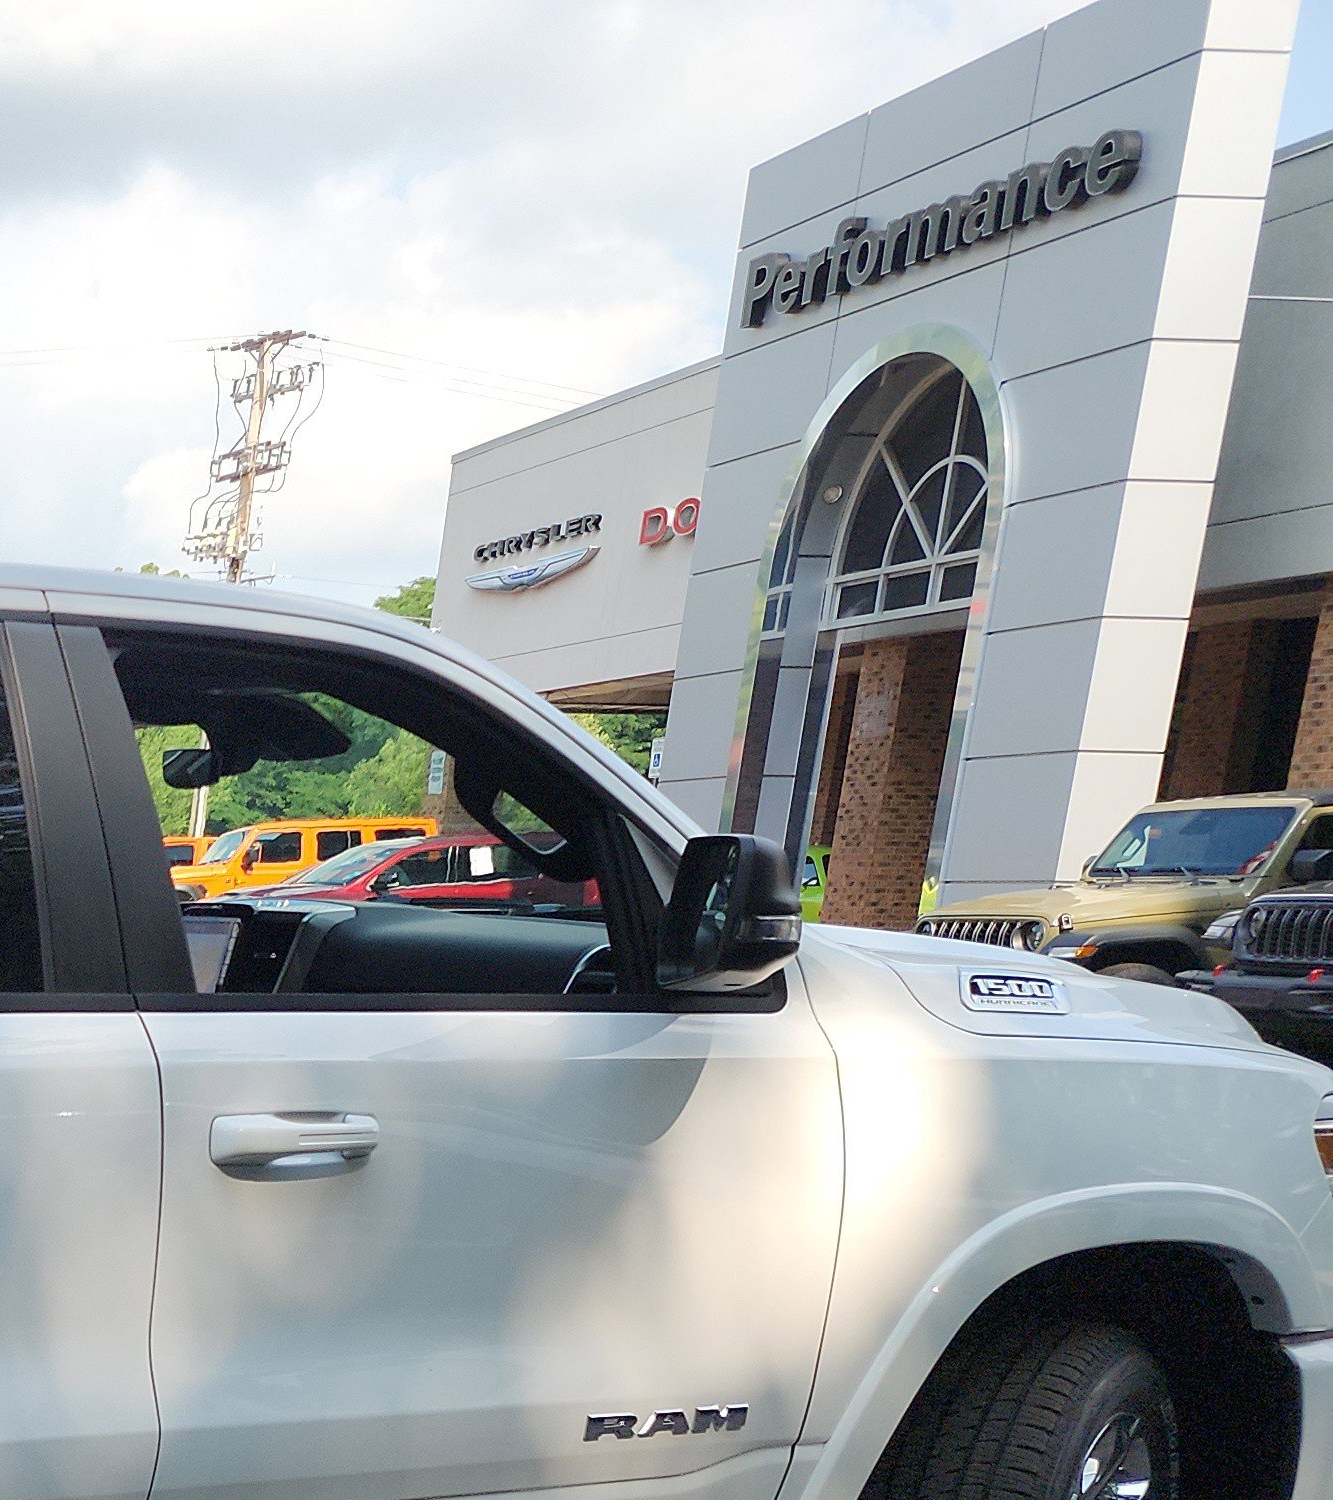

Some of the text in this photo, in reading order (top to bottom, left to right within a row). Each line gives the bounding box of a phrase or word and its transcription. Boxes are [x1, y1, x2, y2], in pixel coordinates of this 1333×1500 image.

[740, 128, 1143, 329] Performance
[473, 513, 602, 562] CHRYSLER
[972, 979, 1053, 997] 1500
[582, 1403, 750, 1442] RAM
